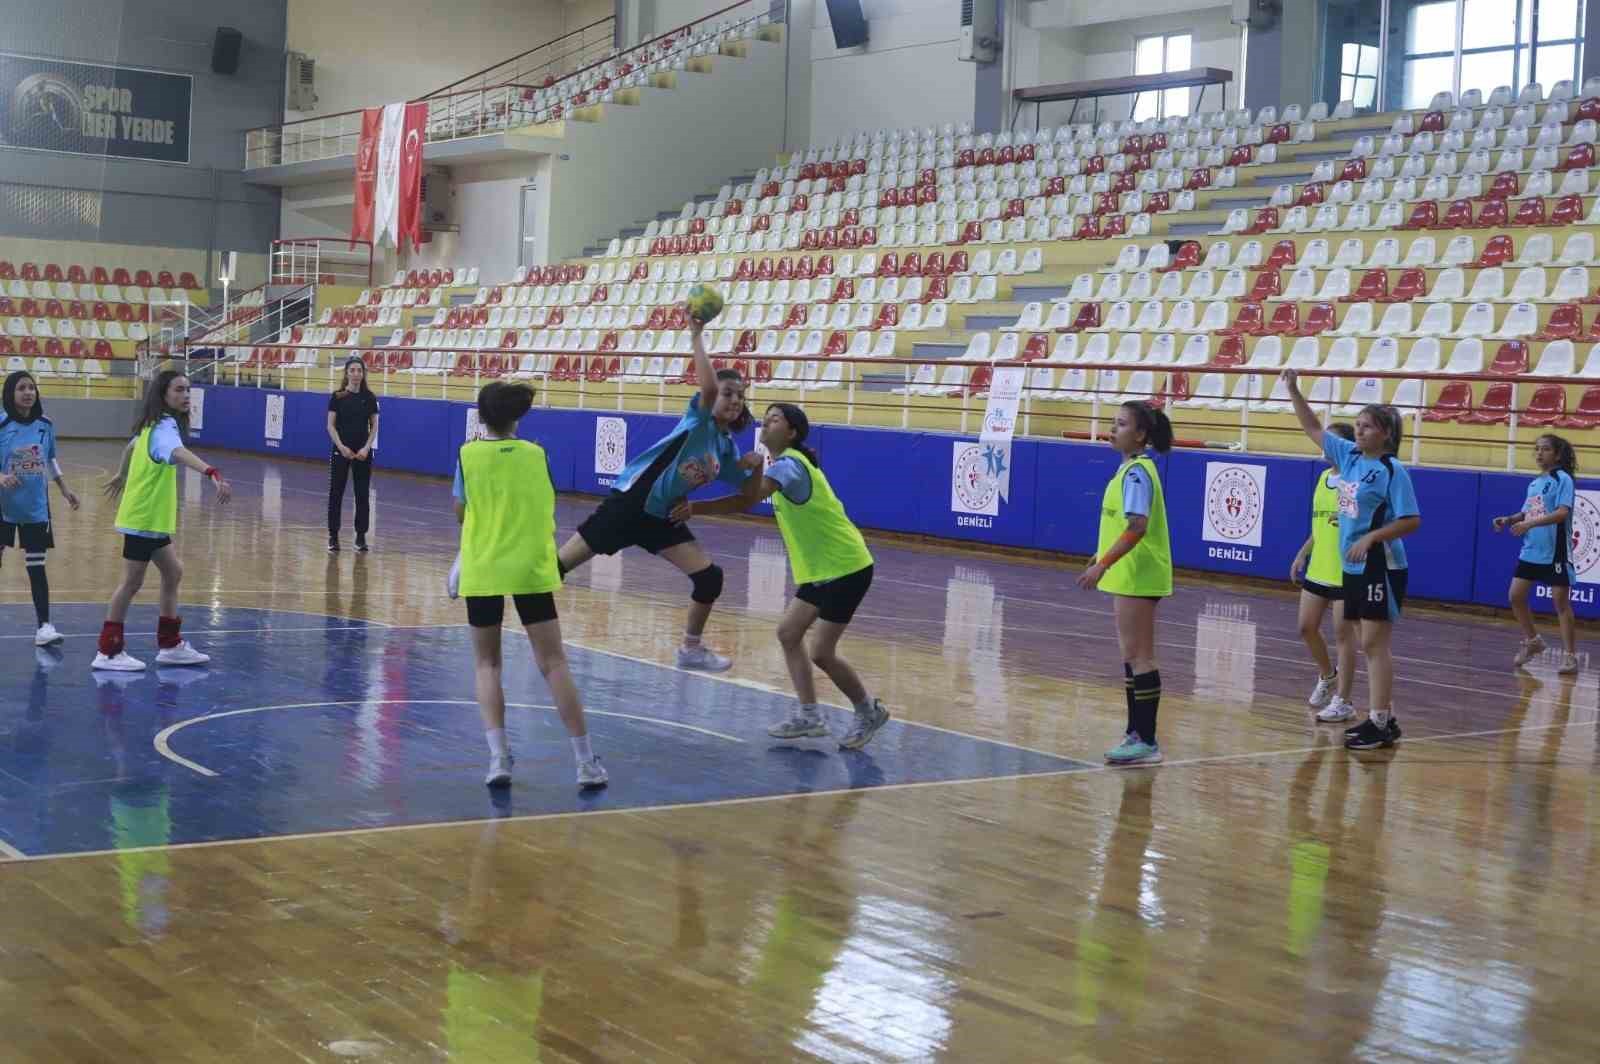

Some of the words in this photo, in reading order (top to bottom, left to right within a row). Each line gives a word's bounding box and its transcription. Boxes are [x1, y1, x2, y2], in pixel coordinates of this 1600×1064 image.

[83, 84, 133, 112] SPOR
[121, 115, 175, 144] YERDE
[38, 429, 46, 444] 7
[1361, 469, 1381, 484] 15
[957, 515, 993, 528] DENİZLİ
[1208, 546, 1253, 562] DENİZLİ
[1367, 583, 1384, 602] 15
